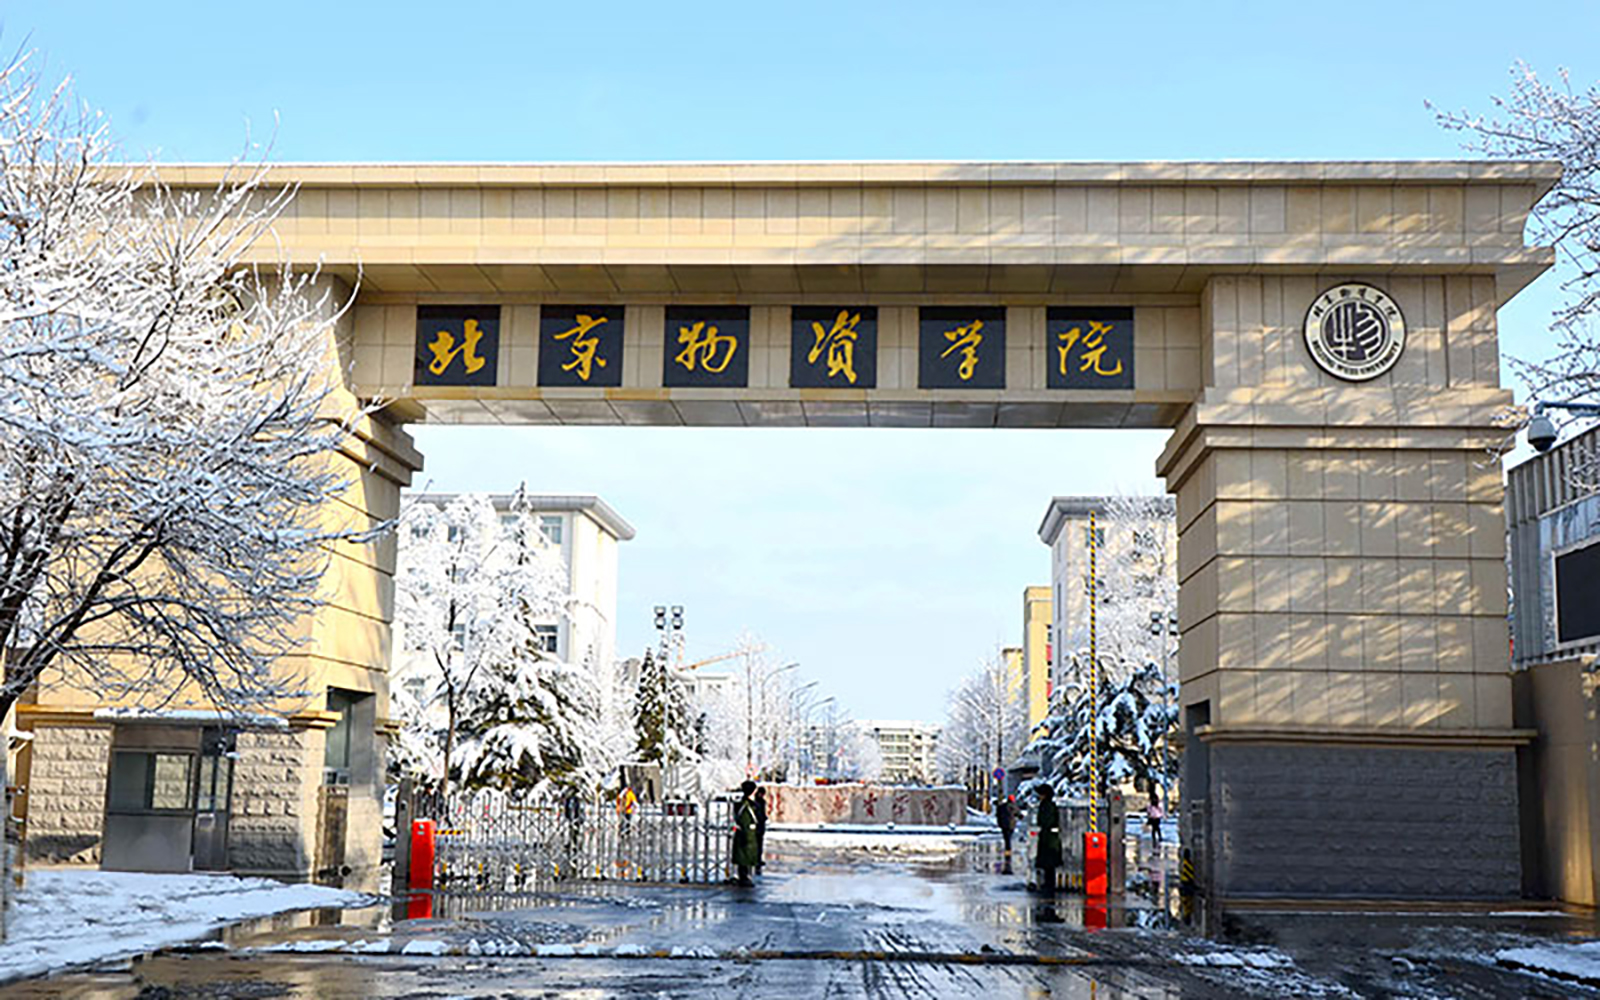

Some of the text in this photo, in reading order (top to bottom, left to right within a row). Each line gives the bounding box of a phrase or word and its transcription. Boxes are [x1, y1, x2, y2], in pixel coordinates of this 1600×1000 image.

[428, 310, 1122, 384] 北京物资学院
